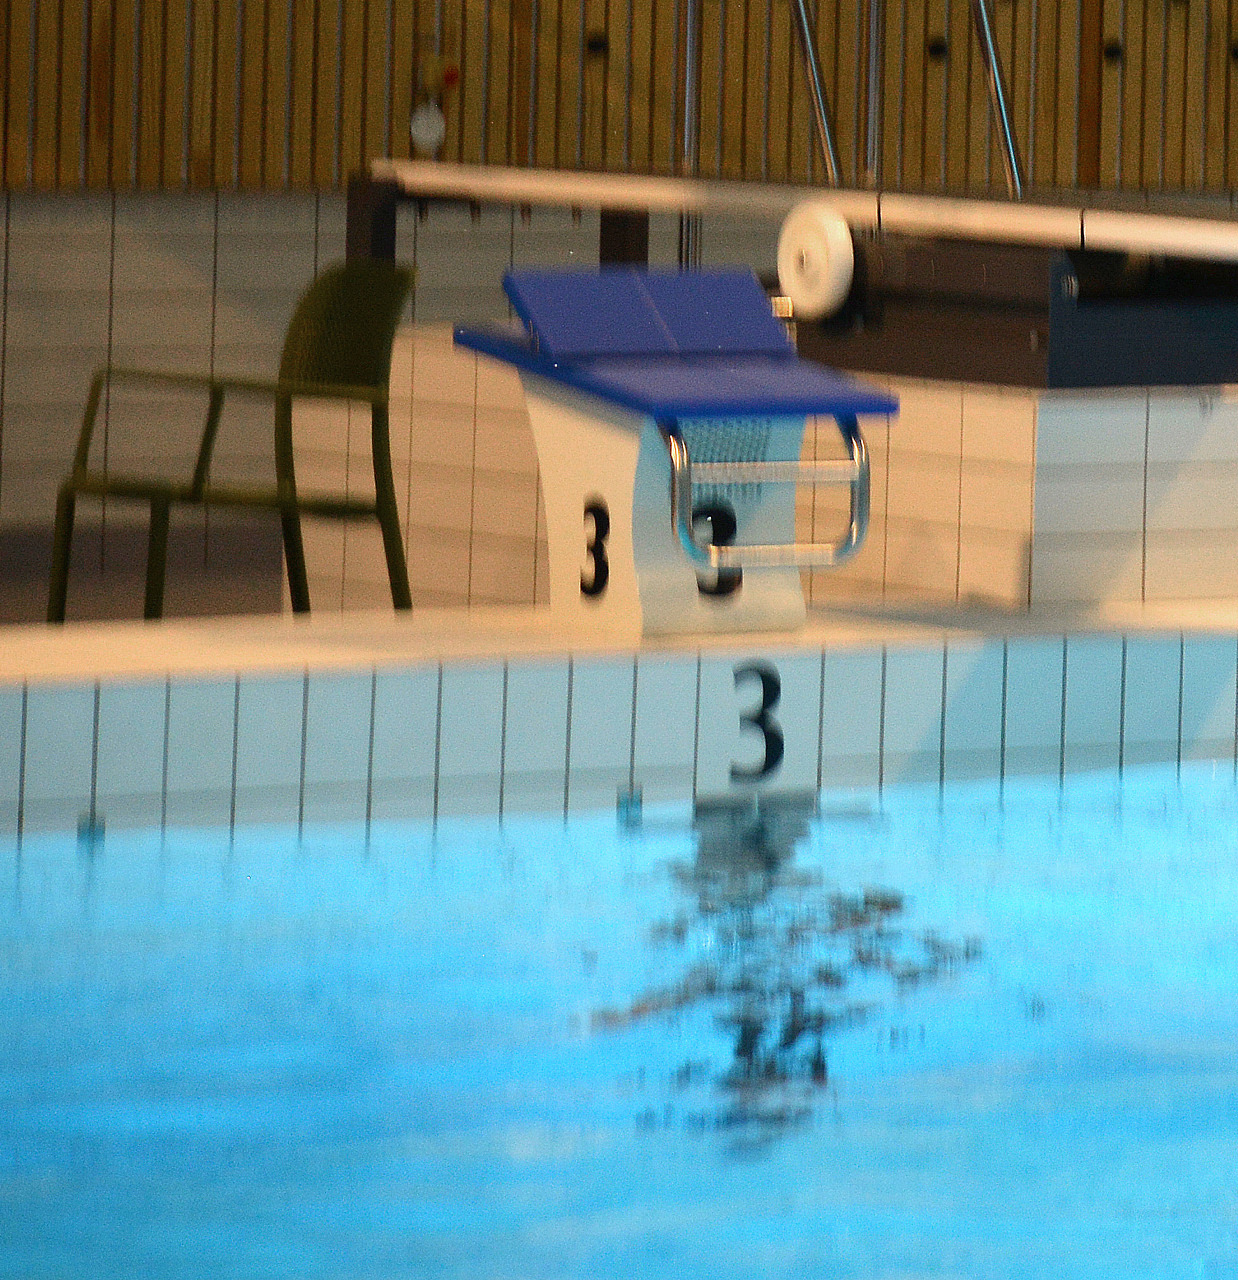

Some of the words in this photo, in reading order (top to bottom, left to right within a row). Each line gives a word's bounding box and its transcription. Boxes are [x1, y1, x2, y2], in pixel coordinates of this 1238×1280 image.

[579, 493, 611, 601] 3
[691, 494, 743, 599] 3
[729, 658, 785, 783] 3
